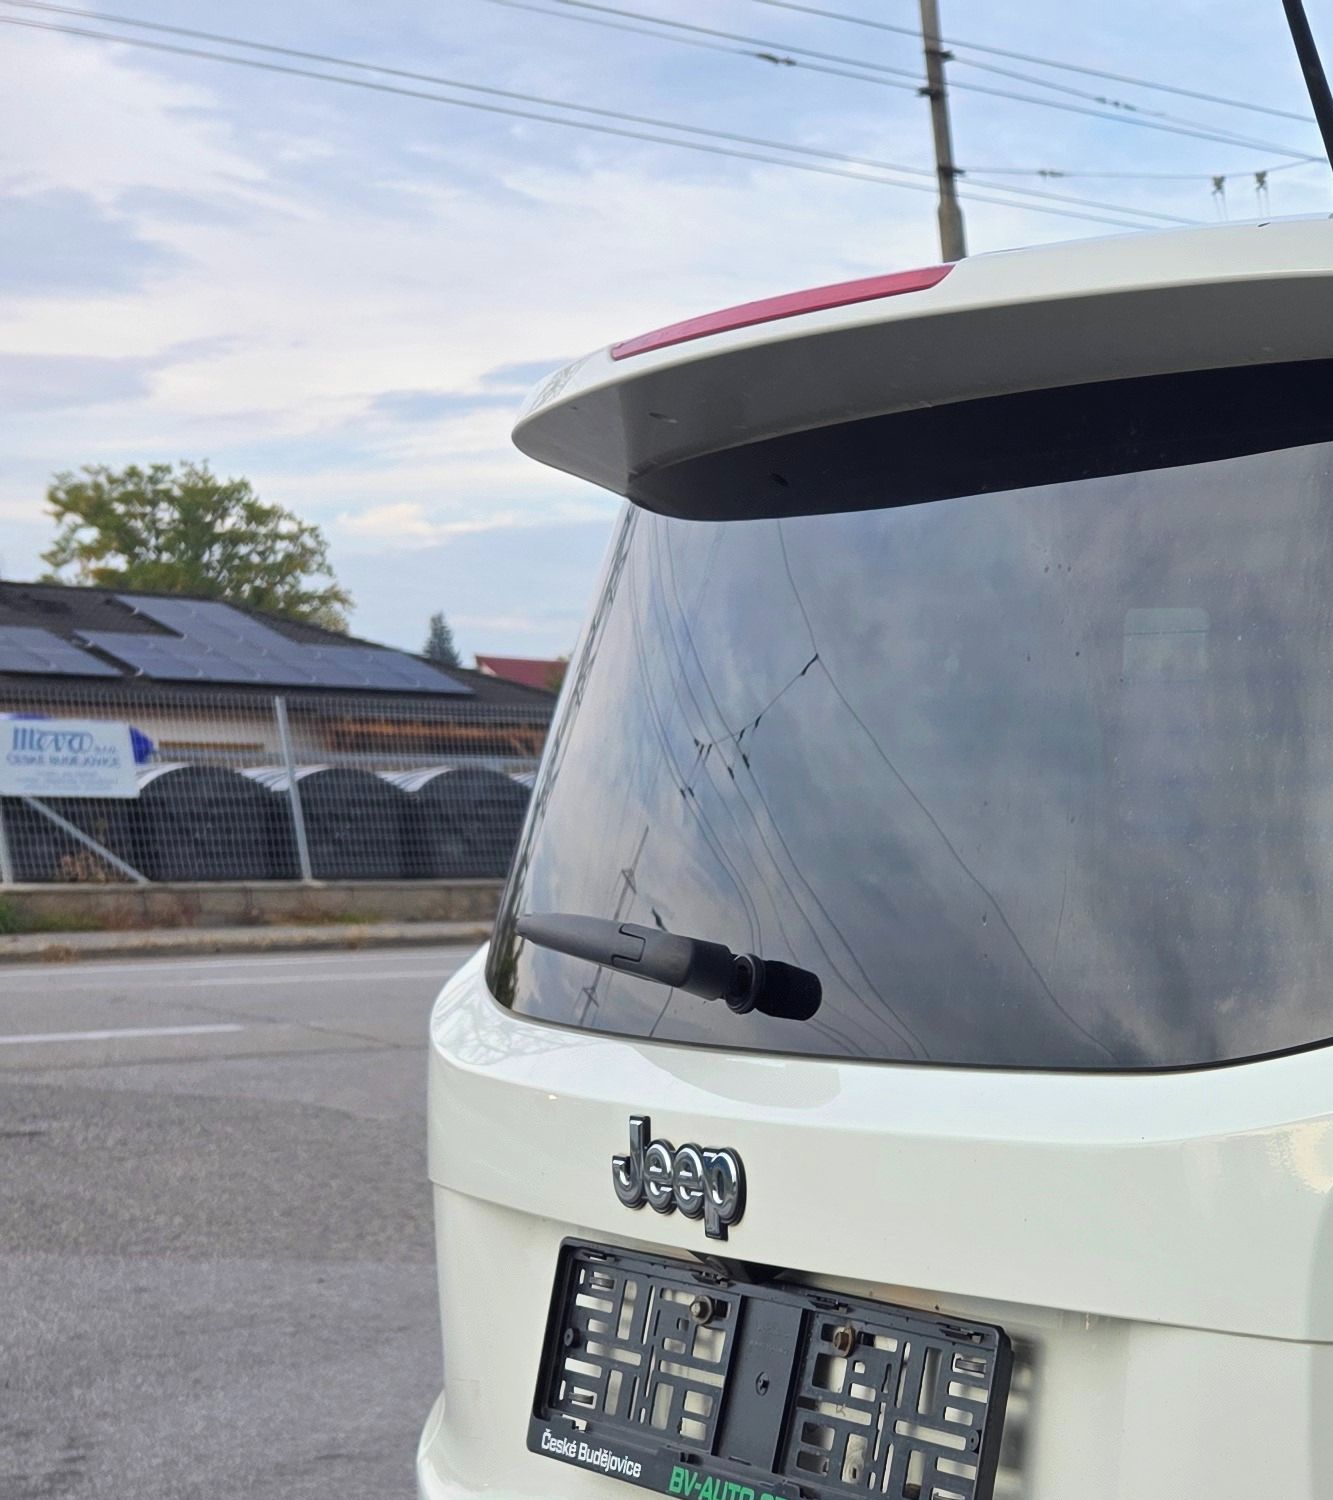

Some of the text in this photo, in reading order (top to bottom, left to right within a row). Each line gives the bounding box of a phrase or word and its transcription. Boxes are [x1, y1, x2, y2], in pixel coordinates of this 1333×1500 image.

[612, 1115, 747, 1242] Jeep
[541, 1428, 642, 1478] České Budějovice
